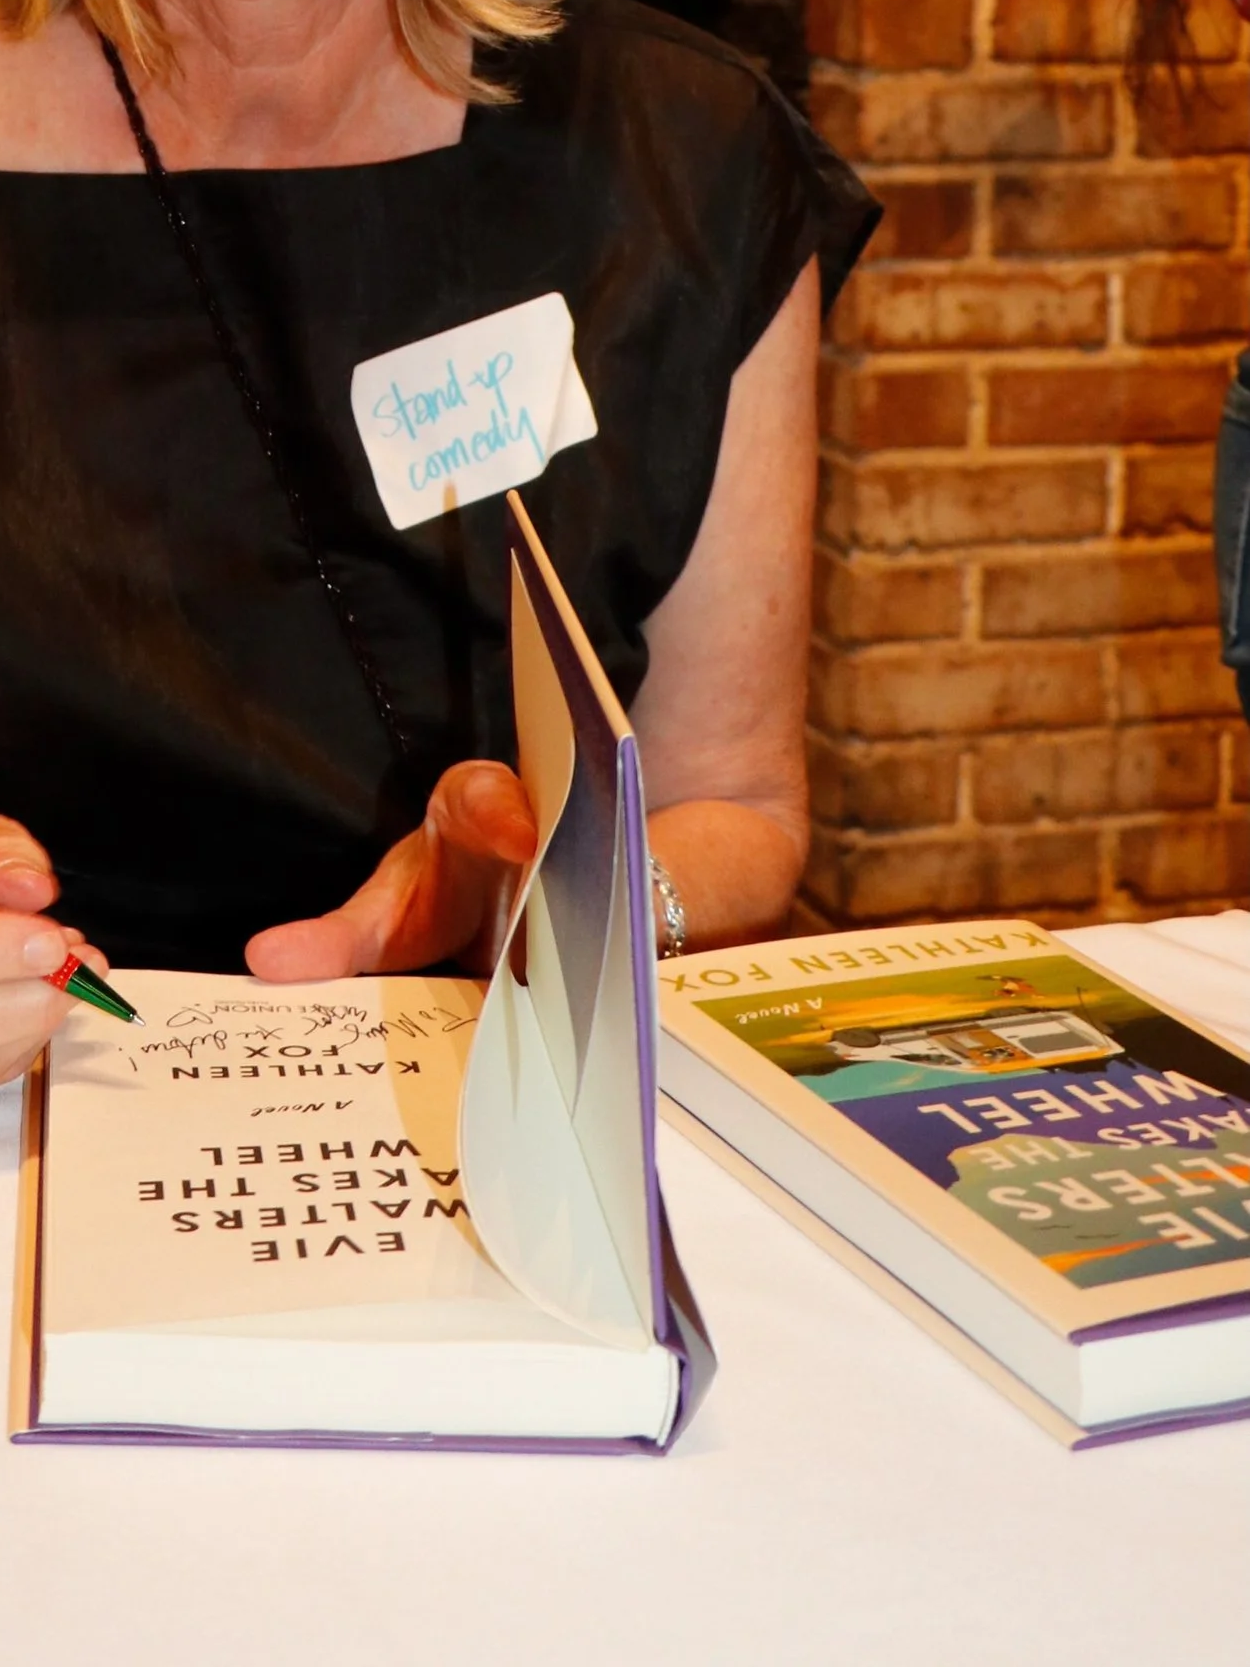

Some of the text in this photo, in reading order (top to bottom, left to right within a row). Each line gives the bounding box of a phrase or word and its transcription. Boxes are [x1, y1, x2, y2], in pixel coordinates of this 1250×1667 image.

[408, 406, 547, 492] comedy
[659, 931, 1050, 993] KATHLEEN FOX
[734, 996, 824, 1025] A Novel
[245, 1044, 340, 1059] FOX
[172, 1060, 422, 1080] KATHLEEN
[250, 1098, 355, 1118] A Novel
[917, 1070, 1228, 1134] WHEEL
[200, 1139, 422, 1166] WHEEL
[966, 1107, 1250, 1171] AKES THE
[138, 1167, 460, 1202] AKES THE
[986, 1152, 1250, 1222] LTERS
[171, 1198, 471, 1233] WALTERS
[1137, 1199, 1250, 1250] IE
[250, 1231, 407, 1263] EVIE
